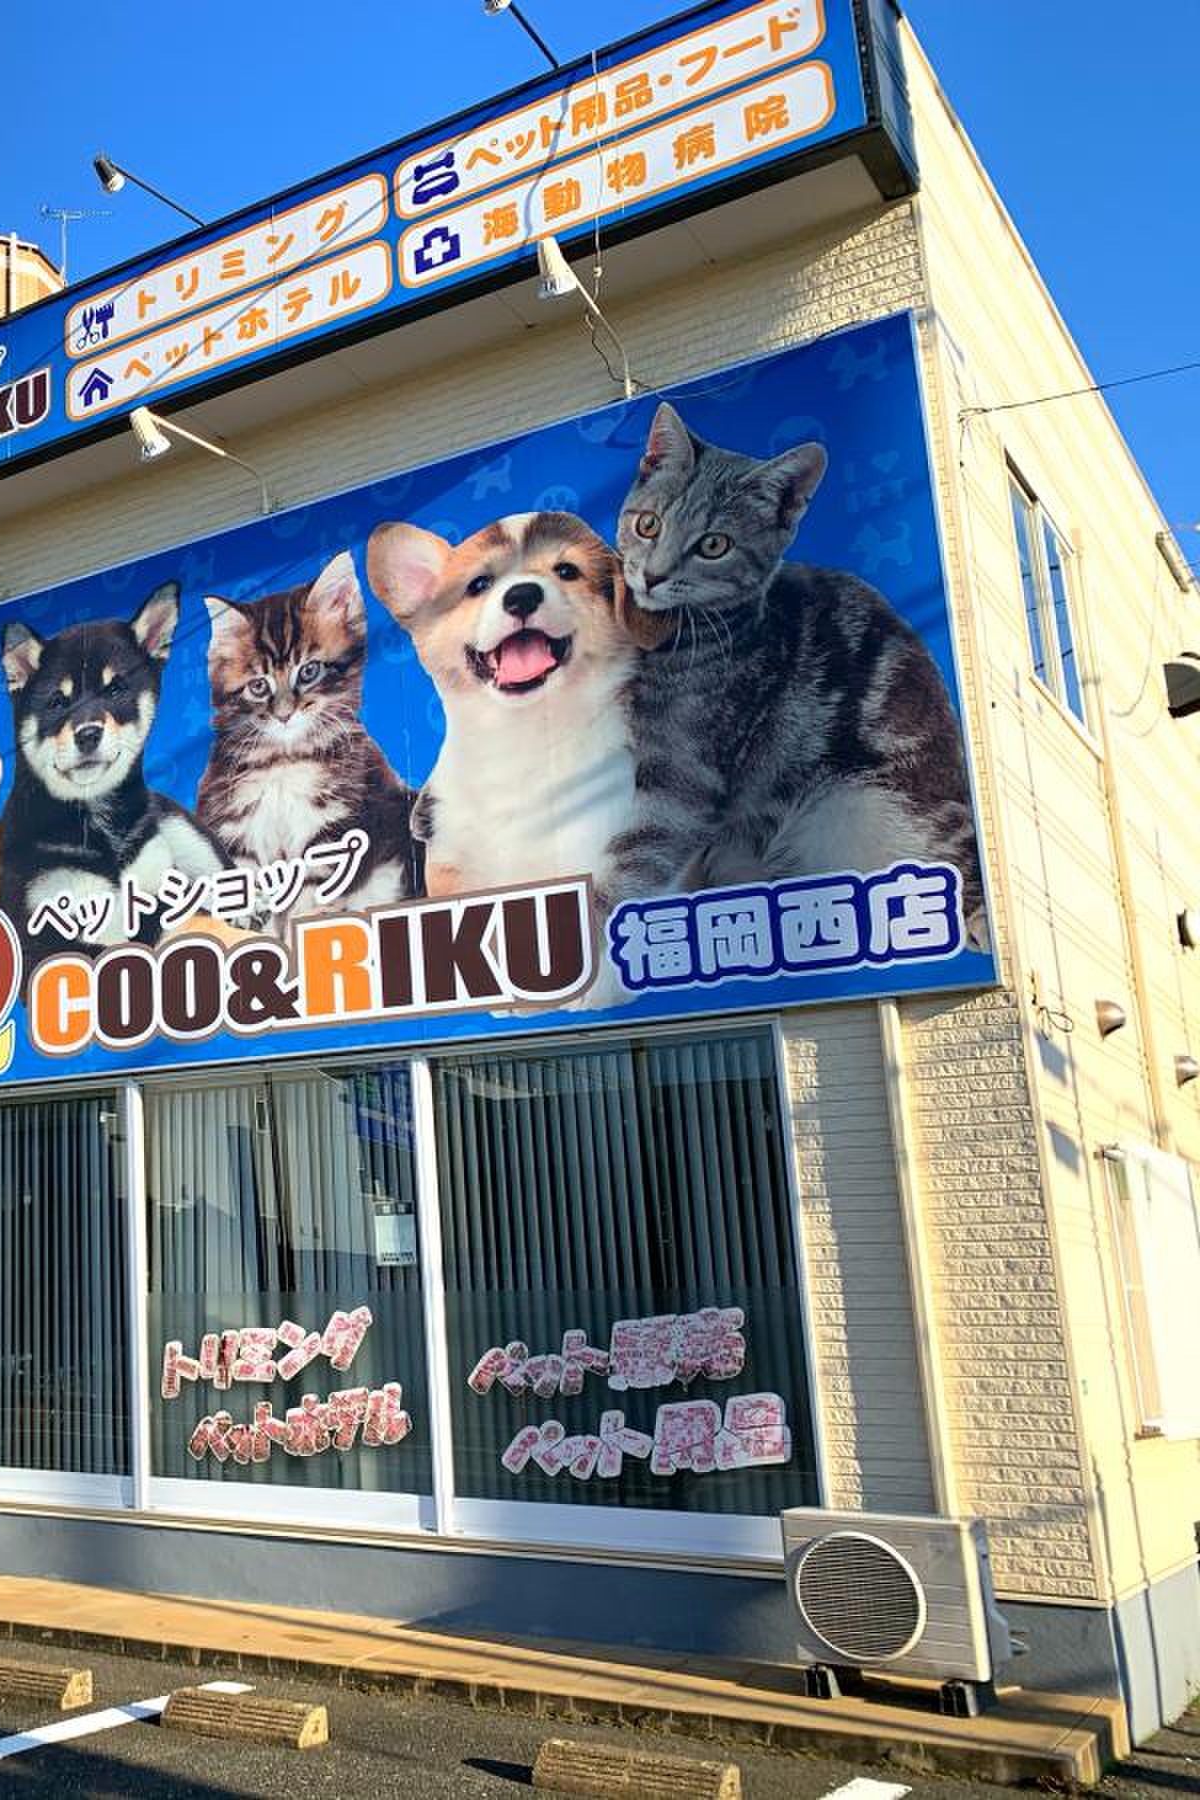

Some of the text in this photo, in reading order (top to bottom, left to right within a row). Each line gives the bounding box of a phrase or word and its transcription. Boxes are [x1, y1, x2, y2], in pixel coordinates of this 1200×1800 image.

[482, 94, 791, 245] 海動物病院
[135, 203, 349, 319] トリミング
[123, 269, 363, 382] ペットホテル
[29, 831, 367, 940] ペットショップ
[616, 874, 948, 982] 福岡西店
[34, 888, 586, 1049] COO&RIKU
[161, 1306, 372, 1399] トリミング
[188, 1382, 412, 1465] ペットホテル
